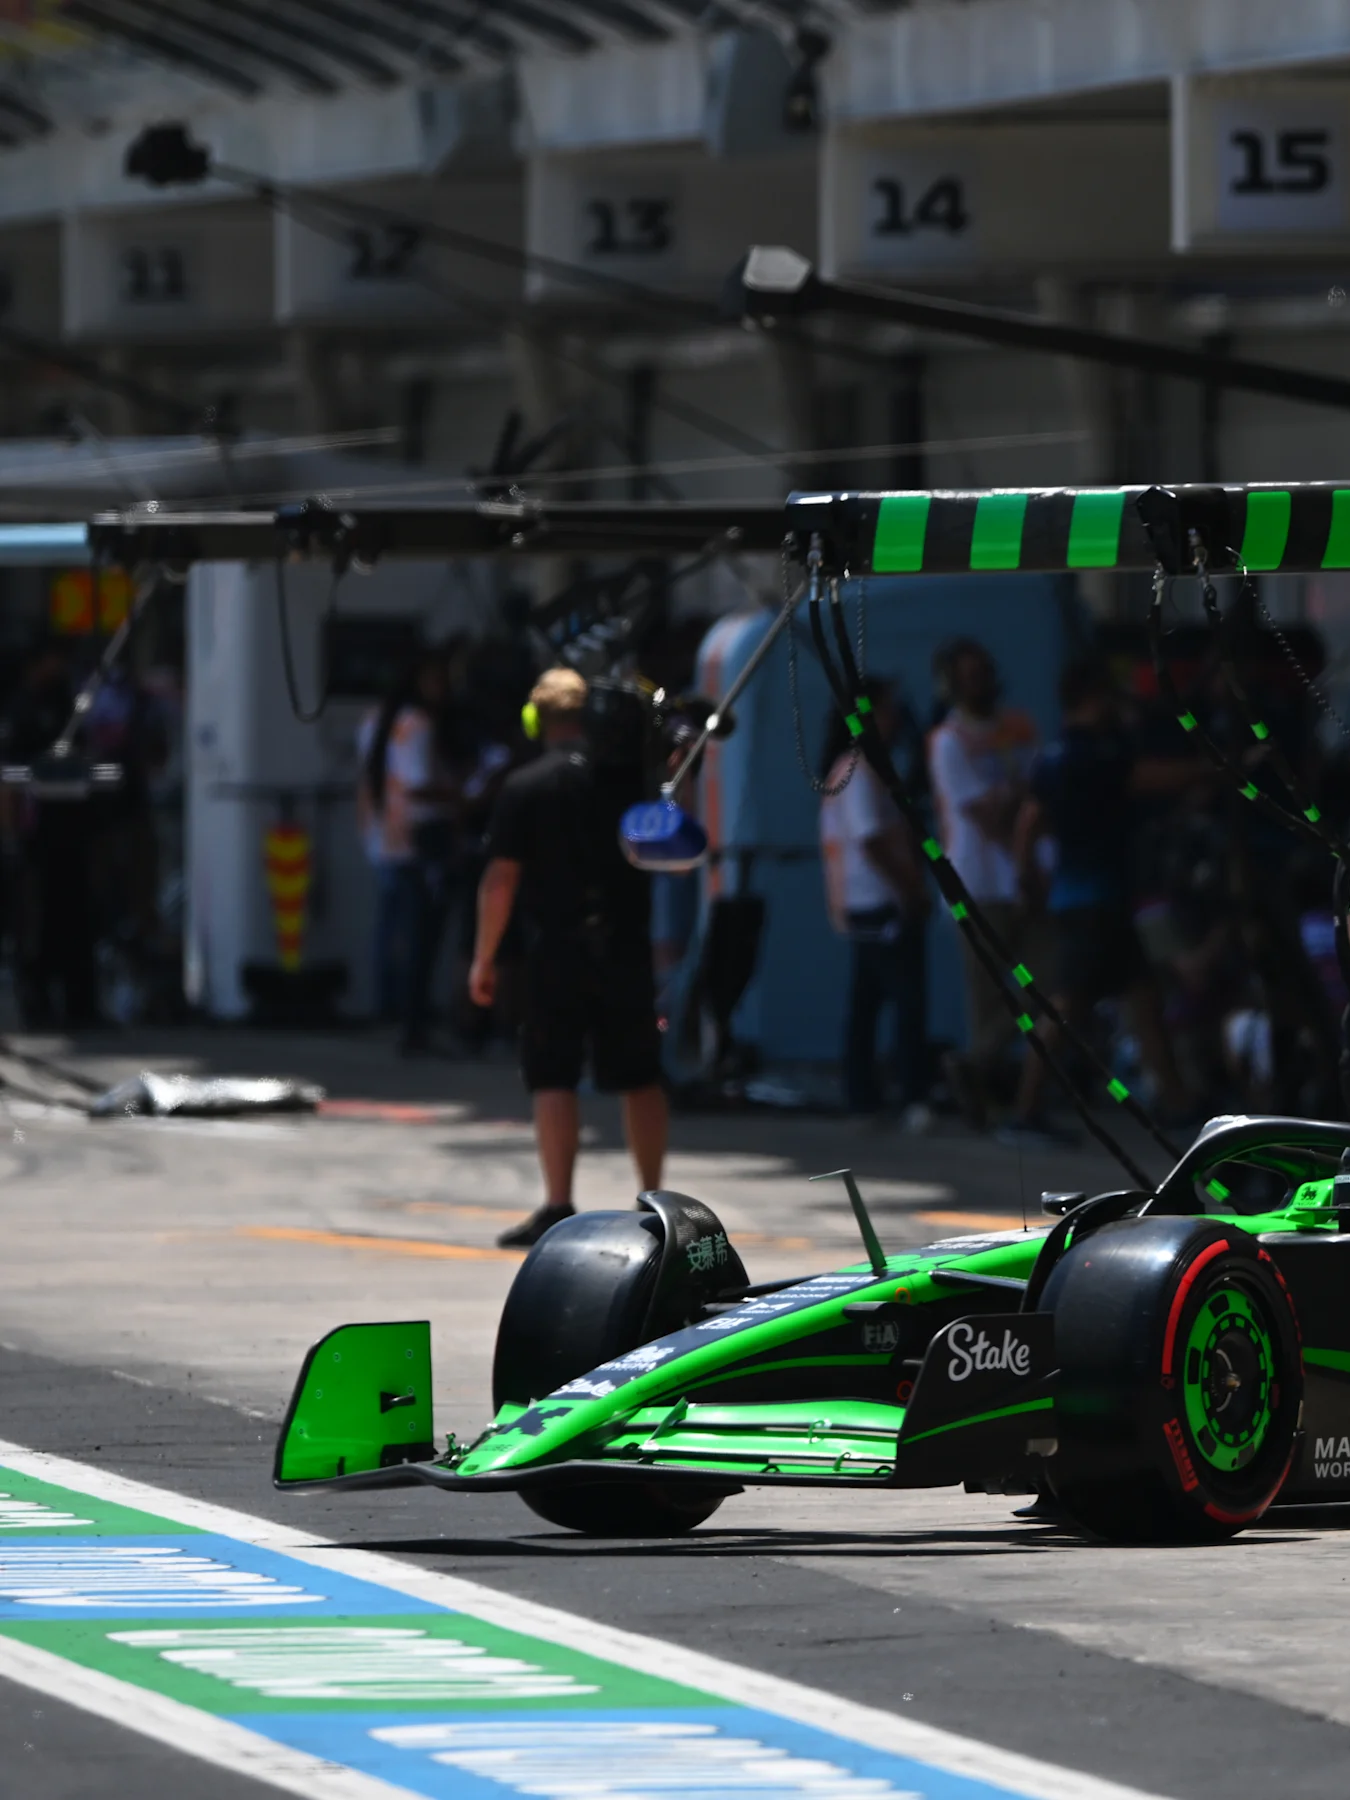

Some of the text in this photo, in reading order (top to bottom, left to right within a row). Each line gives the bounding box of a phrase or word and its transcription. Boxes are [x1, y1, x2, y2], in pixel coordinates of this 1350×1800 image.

[1229, 128, 1331, 195] 15
[586, 198, 672, 255] 13
[873, 174, 969, 237] 14
[124, 247, 185, 299] 11
[947, 1322, 1032, 1382] Stake
